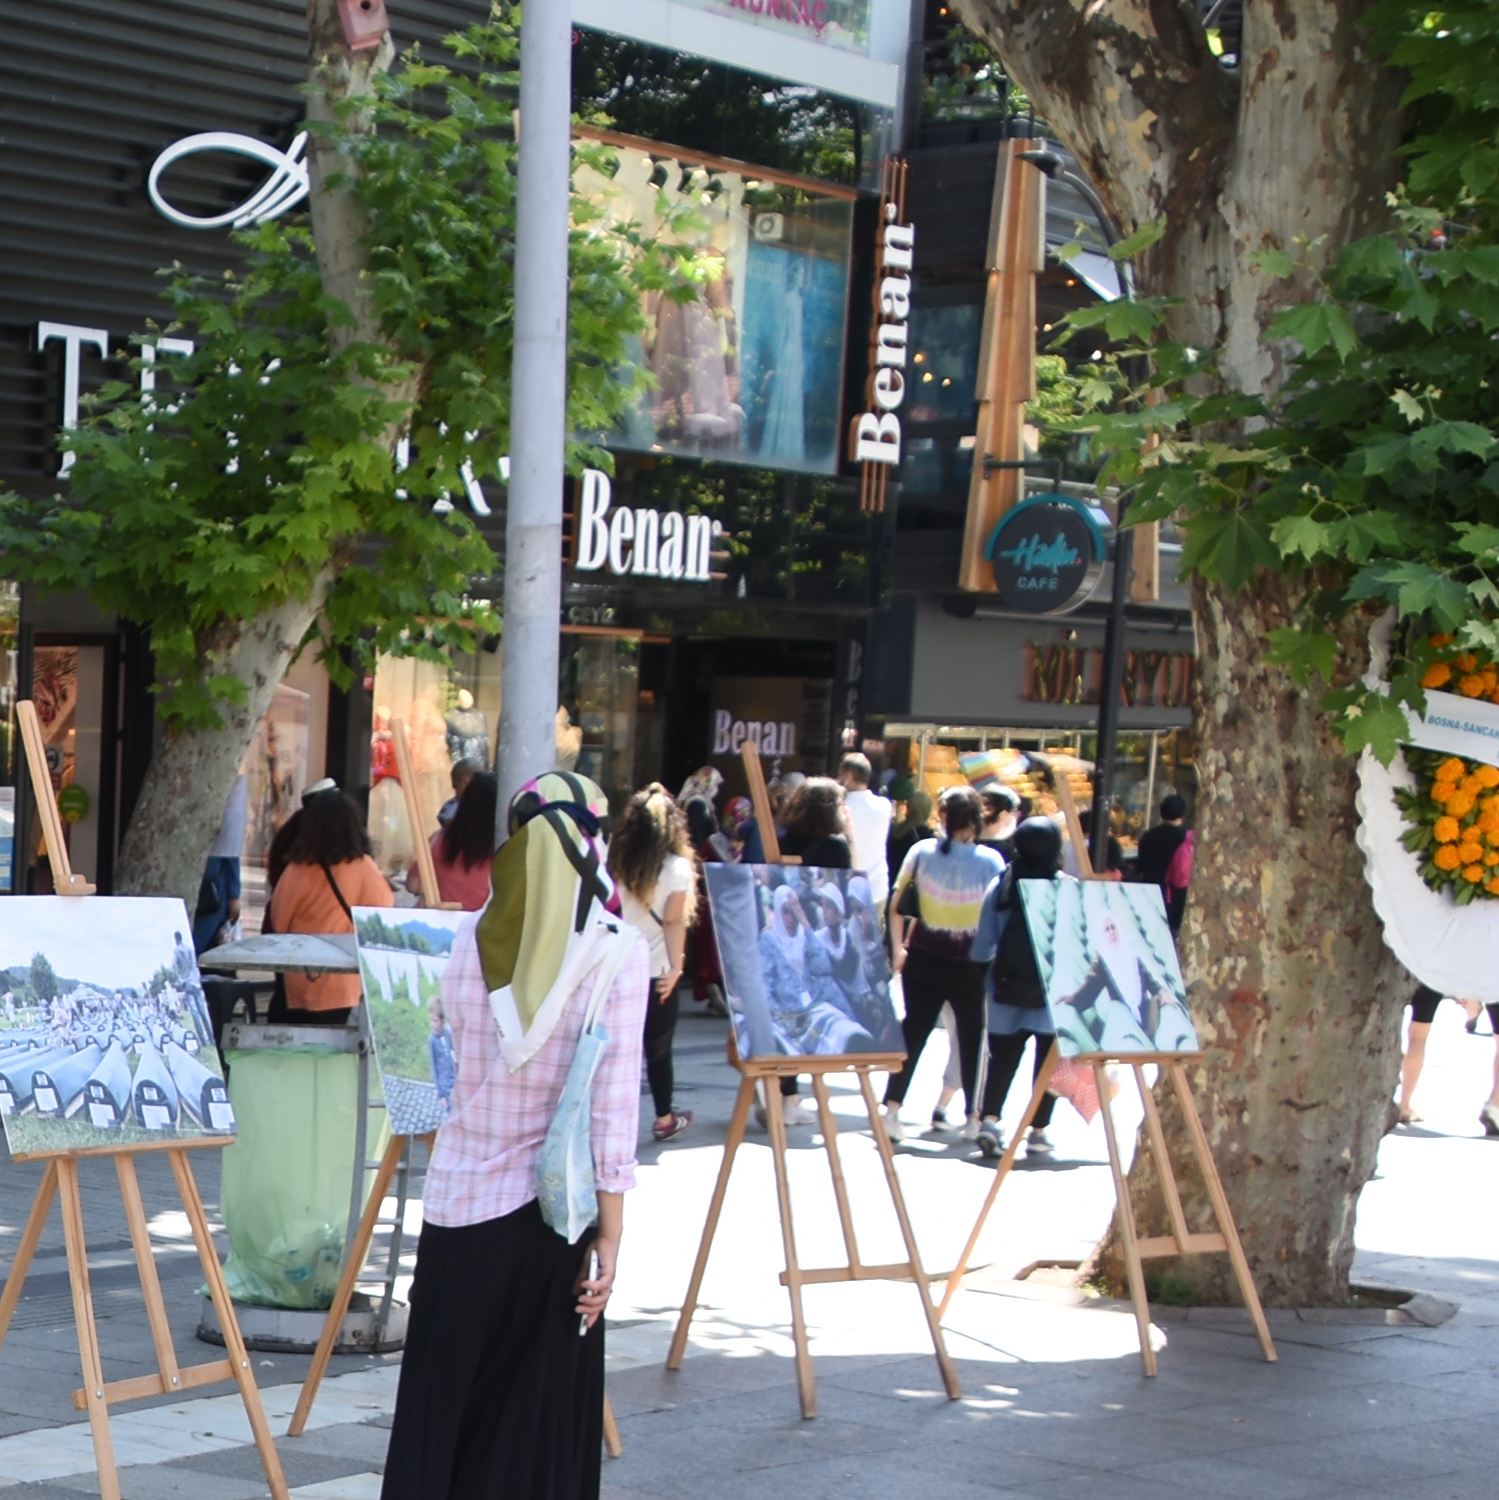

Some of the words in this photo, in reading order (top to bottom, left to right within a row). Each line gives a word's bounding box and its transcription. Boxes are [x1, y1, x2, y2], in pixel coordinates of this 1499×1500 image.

[856, 222, 915, 464] Benan
[576, 468, 711, 582] Benan
[1017, 576, 1059, 590] CAFE
[713, 709, 796, 756] Benan
